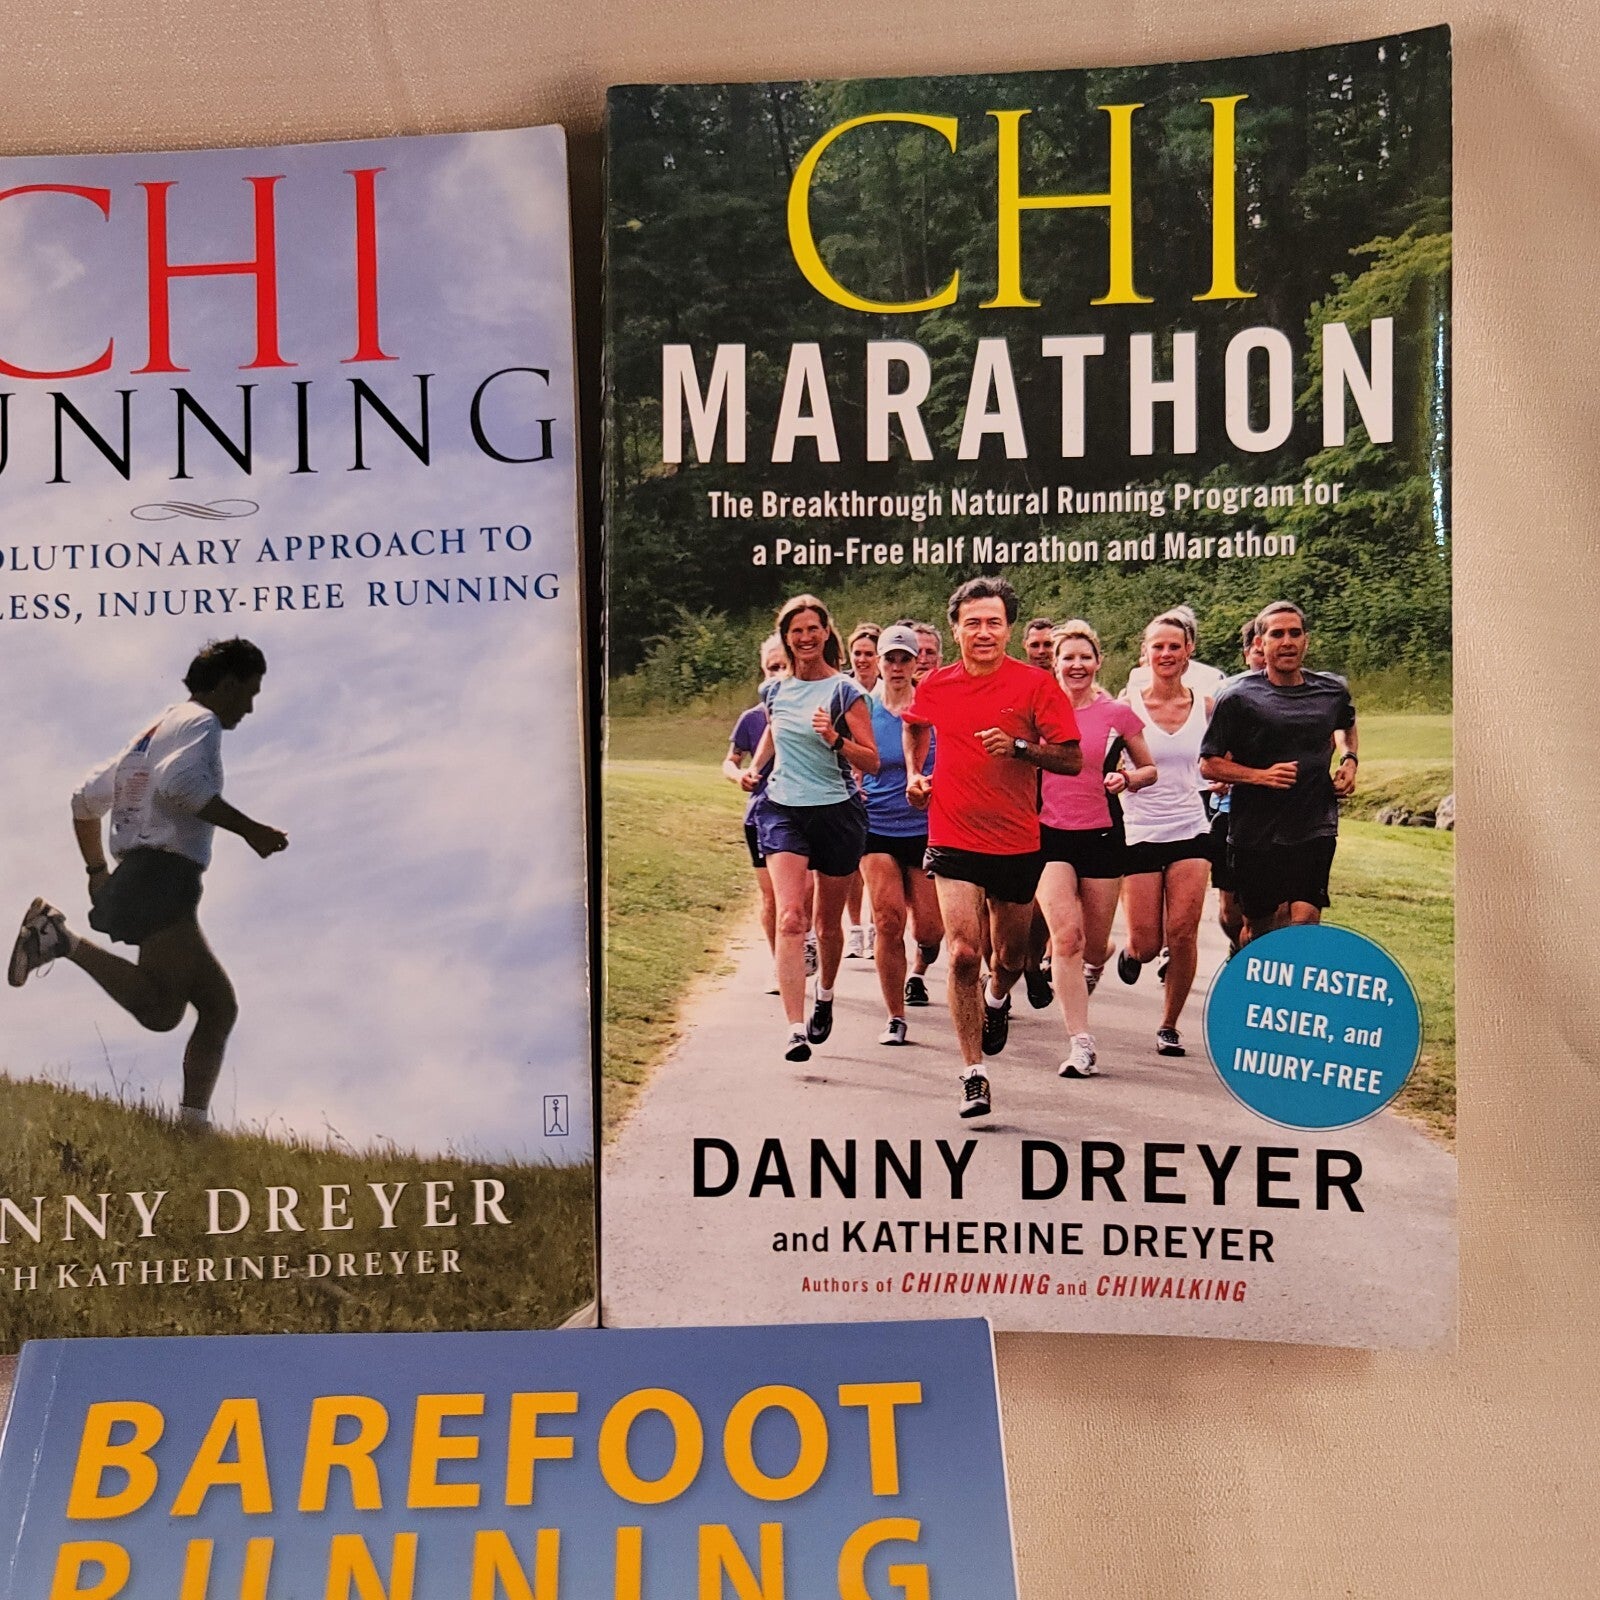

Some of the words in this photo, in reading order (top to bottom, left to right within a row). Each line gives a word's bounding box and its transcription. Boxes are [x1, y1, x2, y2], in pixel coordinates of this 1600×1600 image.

[787, 94, 1256, 314] CHI
[0, 168, 400, 380] CHI
[662, 316, 1395, 465] MARATHON
[0, 367, 557, 484] NNING
[707, 491, 754, 518] The
[762, 488, 943, 523] Breakthrough
[951, 486, 1049, 516] Natural
[1057, 484, 1166, 518] Running
[1174, 482, 1295, 516] Program
[1302, 477, 1344, 506] for
[0, 538, 242, 572] LUTIONARY
[256, 528, 466, 563] APPROACH
[479, 524, 533, 553] TO
[752, 544, 768, 566] a
[776, 538, 905, 566] Pain-Free
[912, 536, 966, 565] Half
[972, 534, 1099, 564] Marathon
[1107, 532, 1156, 562] and
[1164, 529, 1296, 561] Marathon
[98, 583, 345, 618] INJURY-FREE
[367, 572, 561, 607] RUNNING
[1246, 957, 1295, 988] RUN
[1302, 966, 1394, 1007] FASTER,
[1246, 1003, 1335, 1044] EASIER,
[1343, 1027, 1383, 1048] and
[1233, 1047, 1383, 1095] INJURY-FREE
[692, 1137, 979, 1200] DANNY
[1021, 1138, 1366, 1213] DREYER
[204, 1178, 512, 1236] DREYER
[772, 1226, 829, 1254] and
[842, 1220, 1085, 1255] KATHERINE
[1103, 1223, 1276, 1264] DREYER
[57, 1255, 291, 1290] KATHERINE
[308, 1249, 462, 1279] DREYER
[802, 1276, 869, 1294] Authors
[876, 1277, 893, 1293] of
[901, 1271, 1052, 1296] CHIRUNNING
[1056, 1281, 1088, 1296] and
[1095, 1275, 1248, 1303] CHIWALKING
[66, 1382, 923, 1520] BAREFOOT
